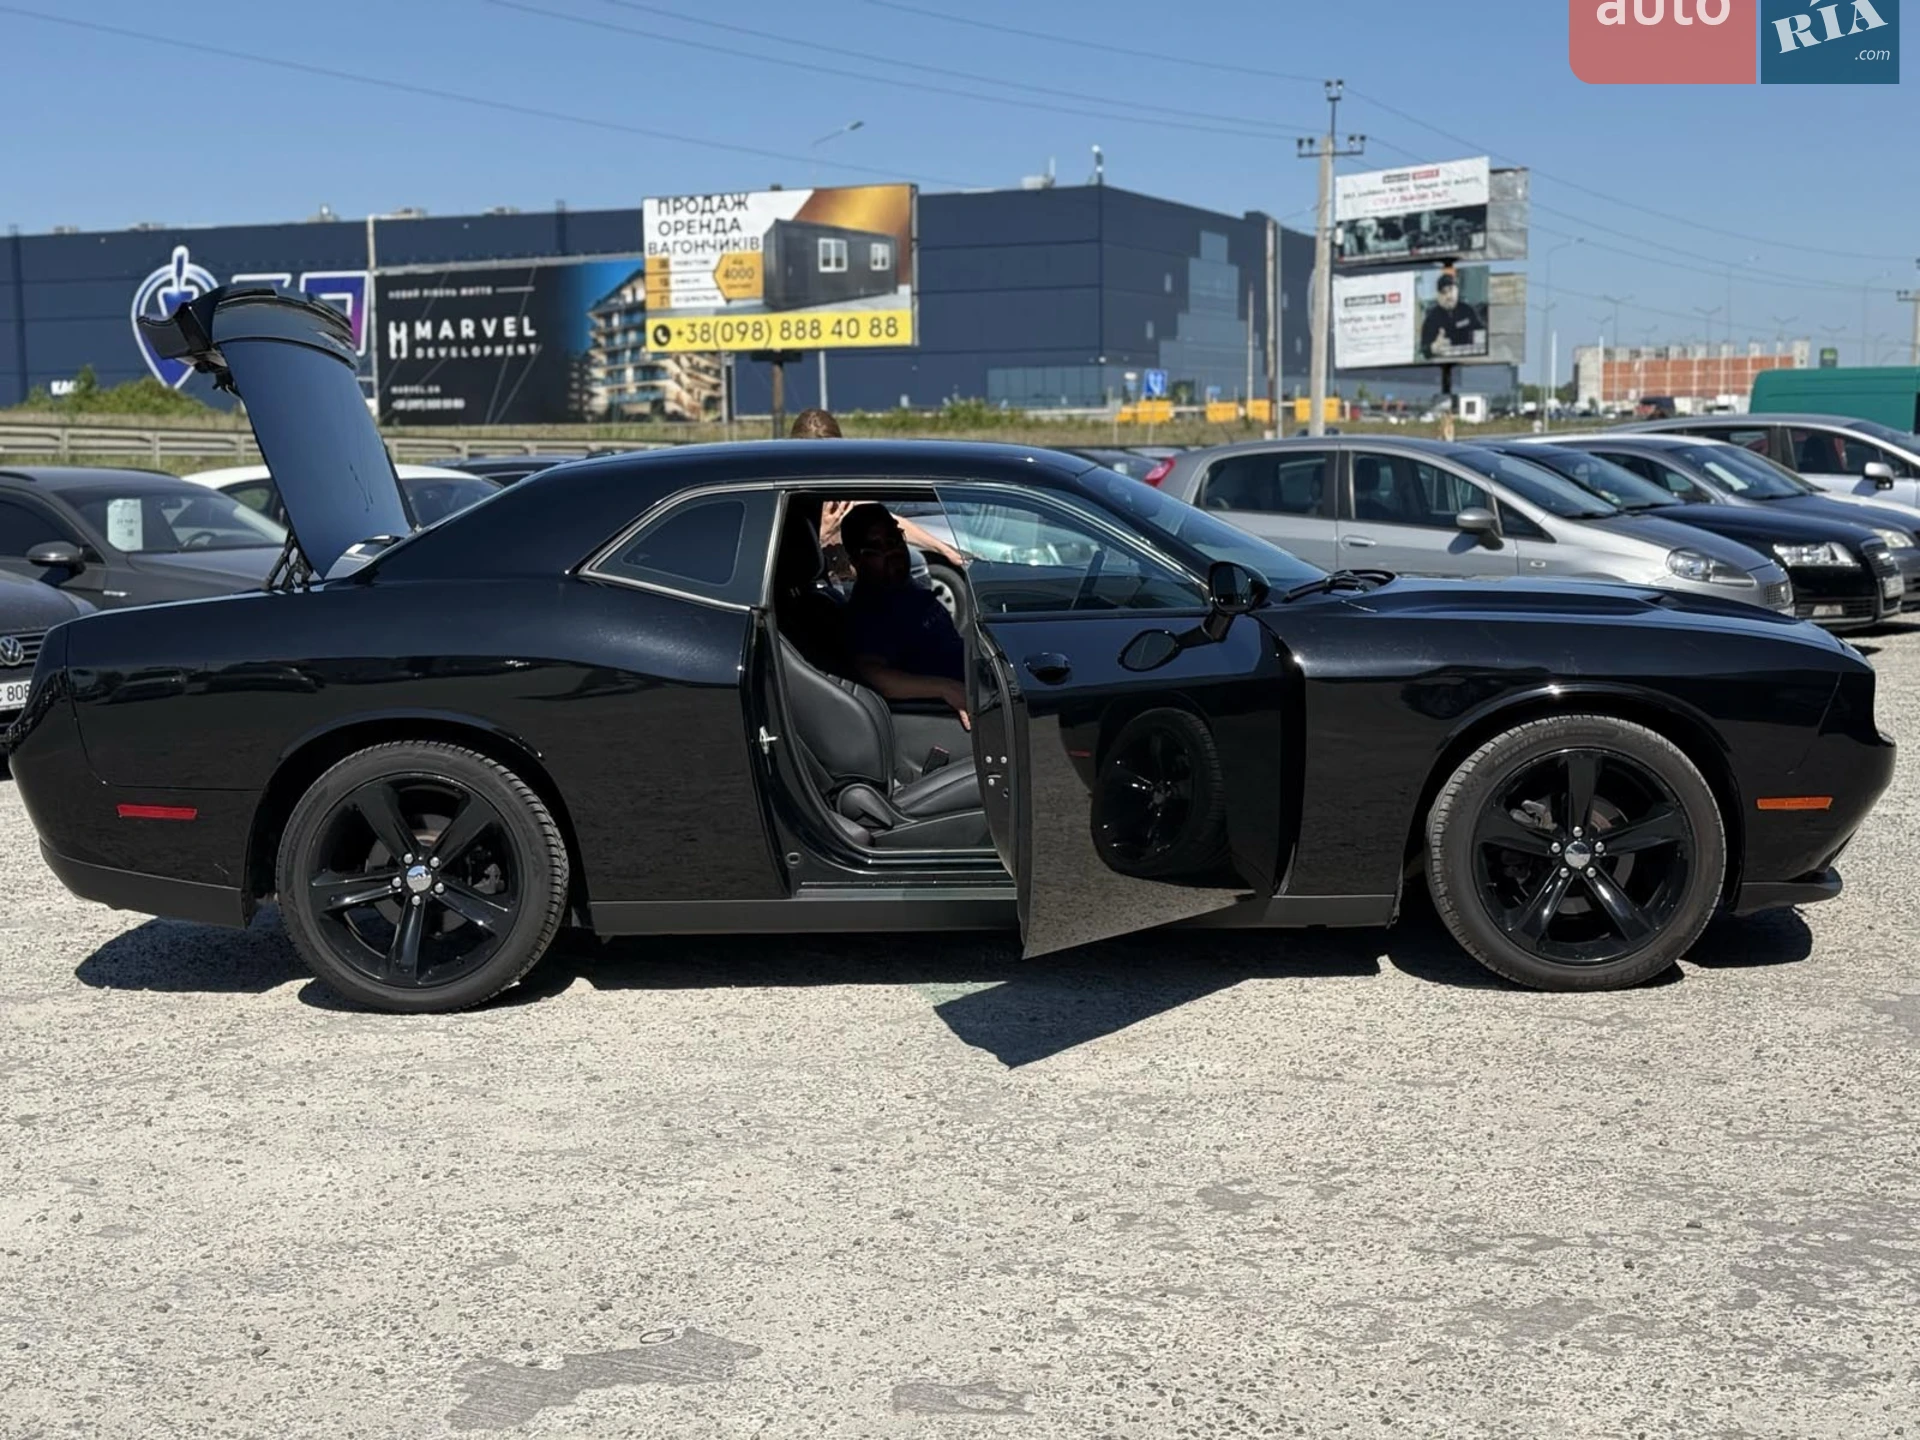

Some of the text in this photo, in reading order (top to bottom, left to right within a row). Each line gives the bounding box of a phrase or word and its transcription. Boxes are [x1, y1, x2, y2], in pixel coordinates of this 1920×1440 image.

[657, 193, 750, 217] ПРОДАЖ
[657, 216, 742, 237] ОРЕНДА
[647, 235, 761, 256] ВАГОНЧИКІВ
[722, 266, 756, 281] 4000
[414, 316, 537, 341] MARVEL
[675, 316, 899, 347] +38(098) 888 40 88
[415, 343, 537, 359] DEVELOPMENT
